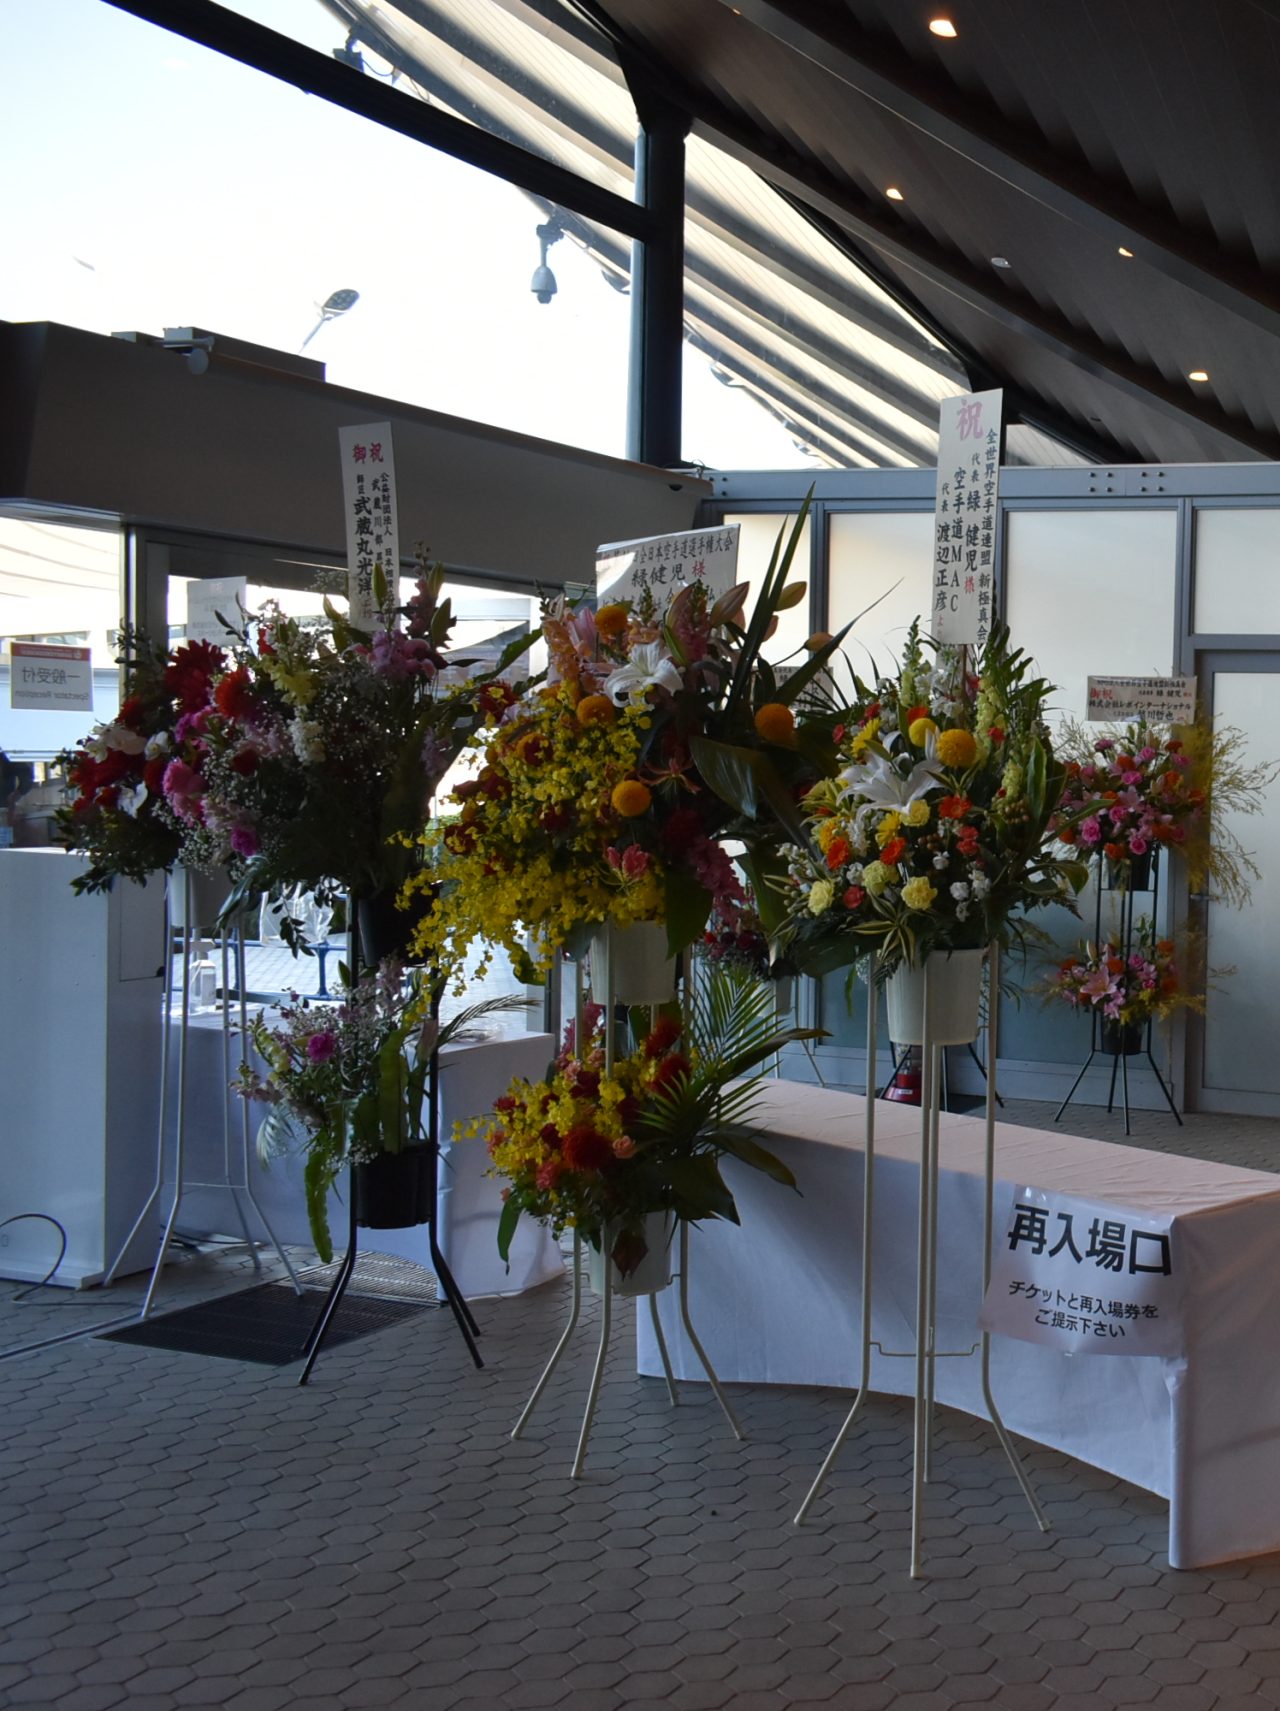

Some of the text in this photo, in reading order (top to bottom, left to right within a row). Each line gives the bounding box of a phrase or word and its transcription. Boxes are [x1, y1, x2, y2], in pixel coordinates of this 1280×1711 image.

[956, 399, 984, 441] 祝
[352, 442, 384, 465] 御祝
[970, 452, 981, 482] 代表
[940, 482, 951, 514] 代表
[353, 494, 375, 597] 武蔵丸光洋
[950, 466, 967, 613] 空手道MAC
[963, 523, 980, 573] 健児
[976, 428, 997, 642] 全世界空手道連盟 新極真会
[934, 523, 951, 613] 渡辺正彦
[1090, 688, 1113, 700] 御祝
[1007, 1204, 1172, 1276] 再入場口
[1009, 1280, 1159, 1320] チケットと再入場券を
[1034, 1308, 1126, 1338] ご提示下さい
